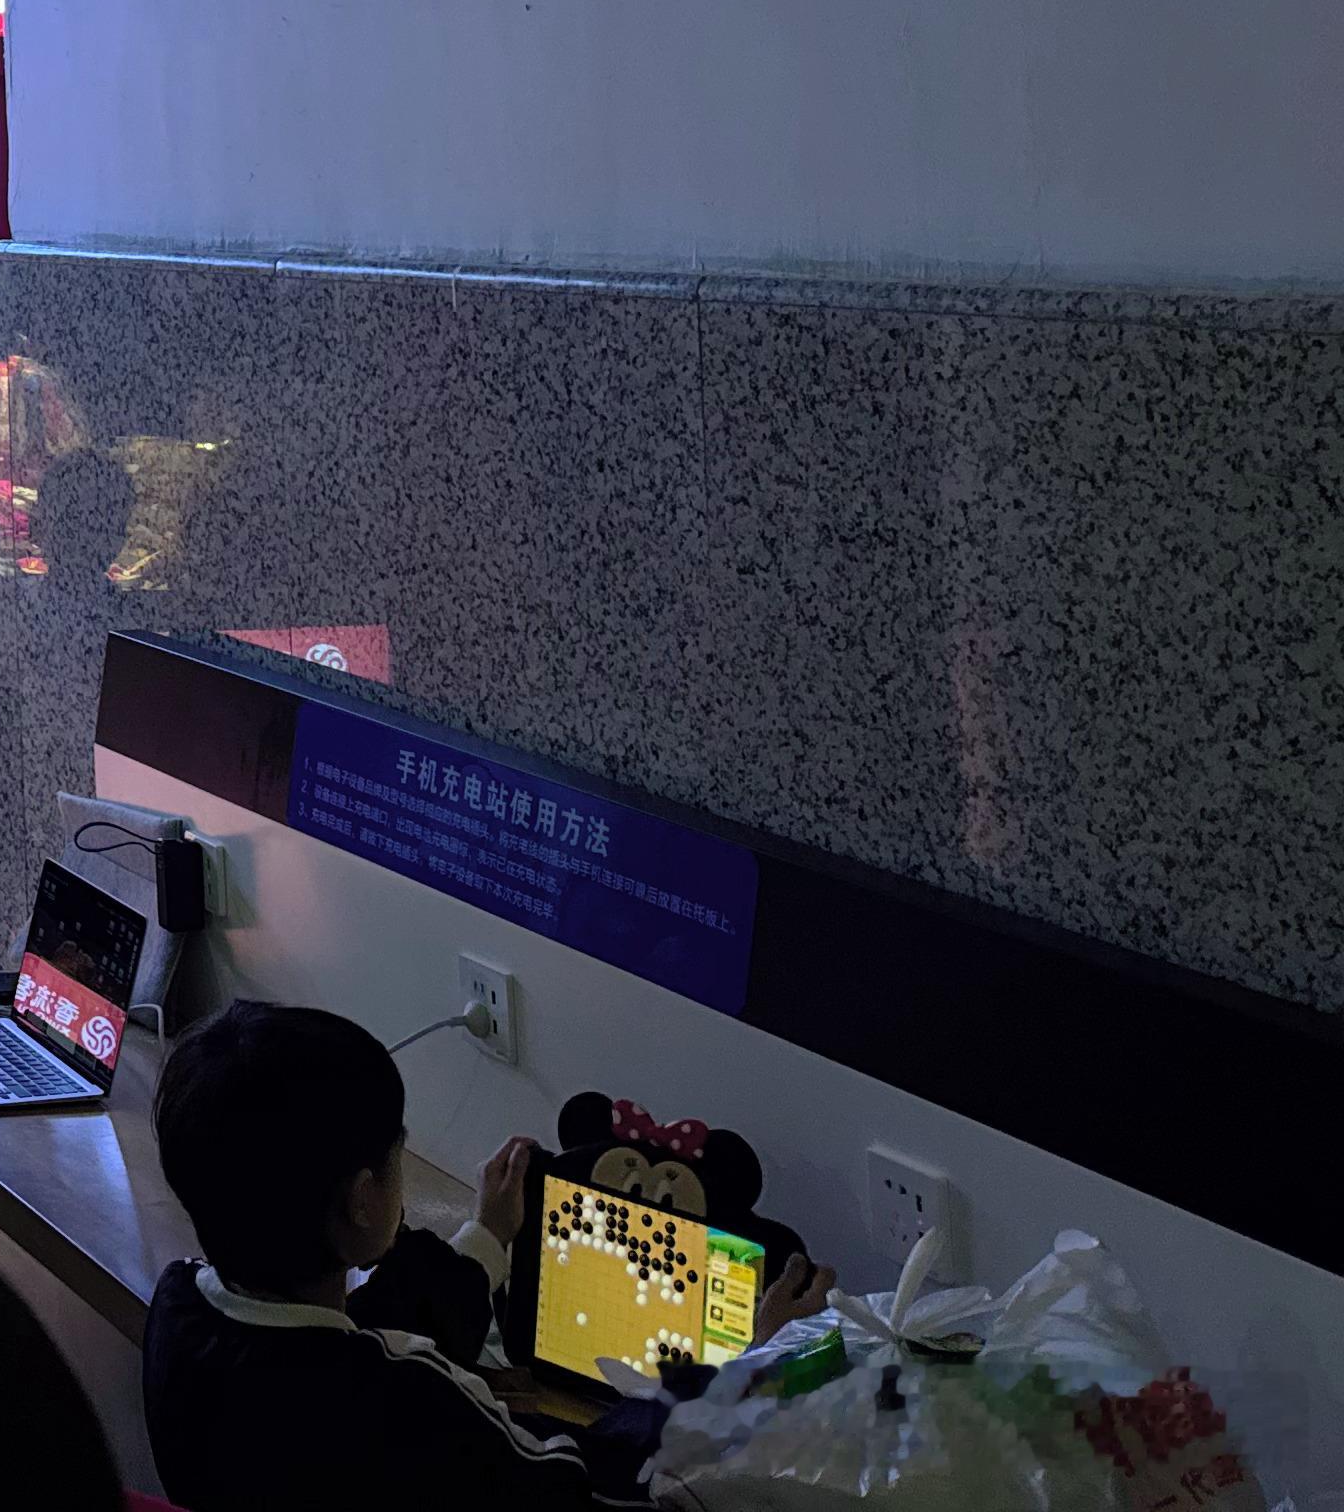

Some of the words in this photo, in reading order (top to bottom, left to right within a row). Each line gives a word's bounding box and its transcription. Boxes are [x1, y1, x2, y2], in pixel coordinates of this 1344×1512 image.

[395, 748, 612, 858] 手机充电站使用方法
